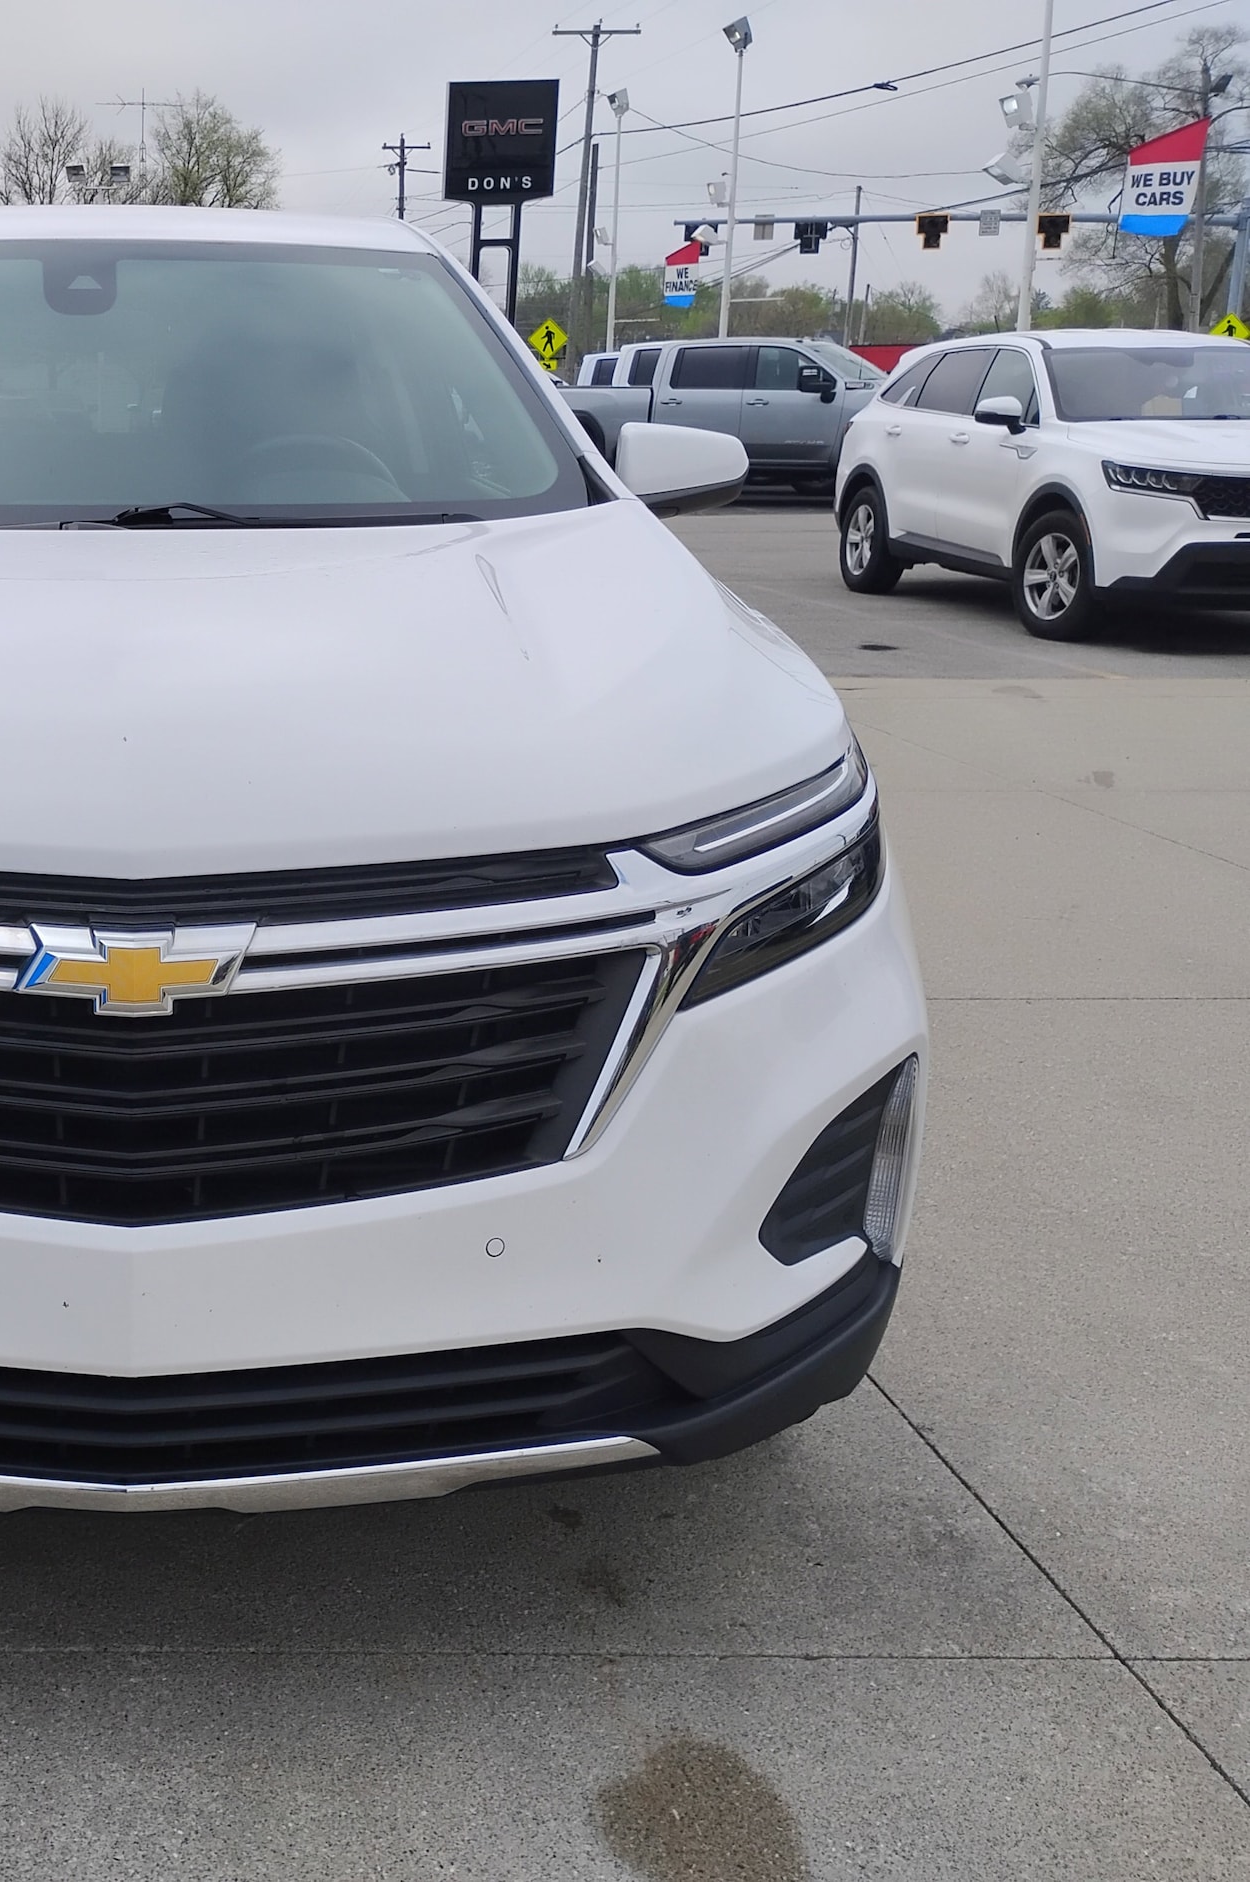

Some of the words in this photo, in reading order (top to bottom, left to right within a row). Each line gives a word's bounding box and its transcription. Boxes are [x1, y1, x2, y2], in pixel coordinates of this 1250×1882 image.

[462, 118, 543, 136] GMC
[467, 176, 532, 191] DON'S
[1131, 173, 1154, 188] WE
[1158, 170, 1195, 187] BUY
[1135, 191, 1184, 207] CARS
[676, 267, 689, 279] WE
[665, 280, 698, 293] FINANCE
